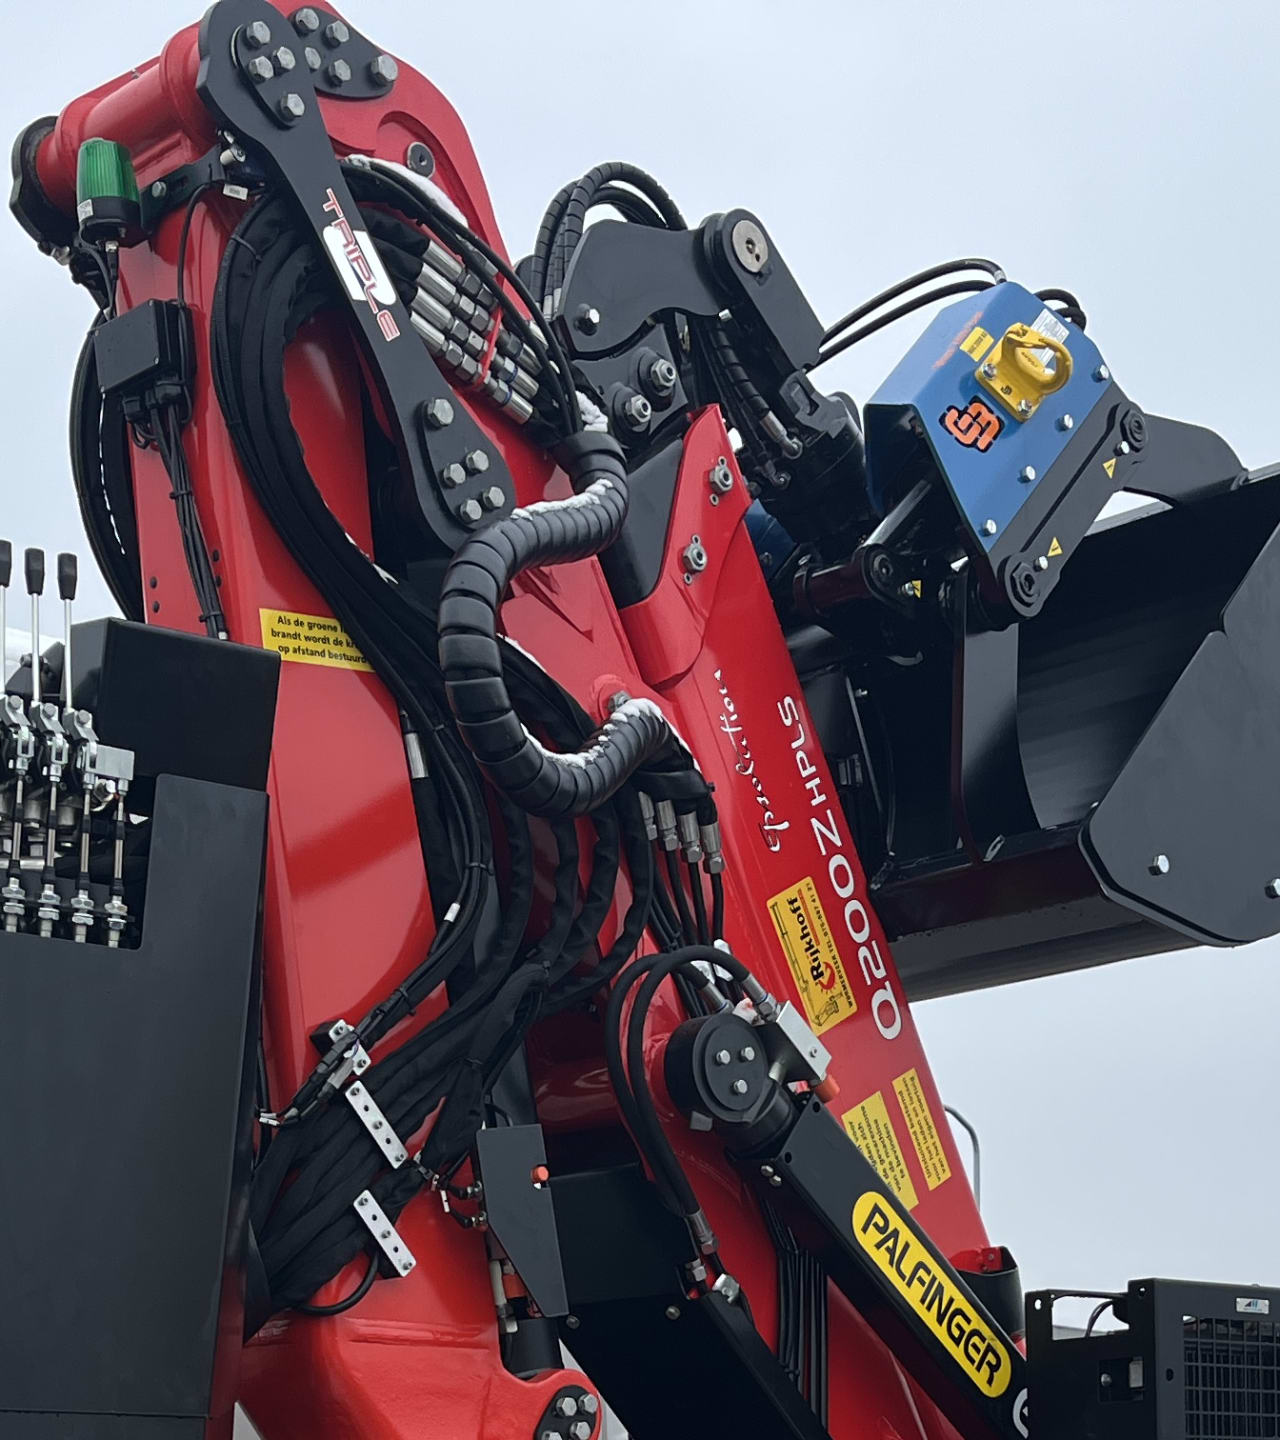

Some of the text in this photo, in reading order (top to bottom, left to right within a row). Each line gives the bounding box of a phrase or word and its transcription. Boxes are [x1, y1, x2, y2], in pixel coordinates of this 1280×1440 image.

[322, 187, 401, 342] TRIPLE
[271, 628, 302, 641] brandt
[303, 633, 331, 645] wordt
[333, 637, 344, 646] de
[277, 615, 291, 626] Als
[294, 618, 305, 627] de
[307, 621, 338, 633] groene
[278, 645, 290, 654] op
[292, 646, 326, 658] afstand
[777, 696, 827, 807] HPLS
[787, 897, 825, 982] Rijkhoff
[861, 1202, 1002, 1388] PALFINGER
